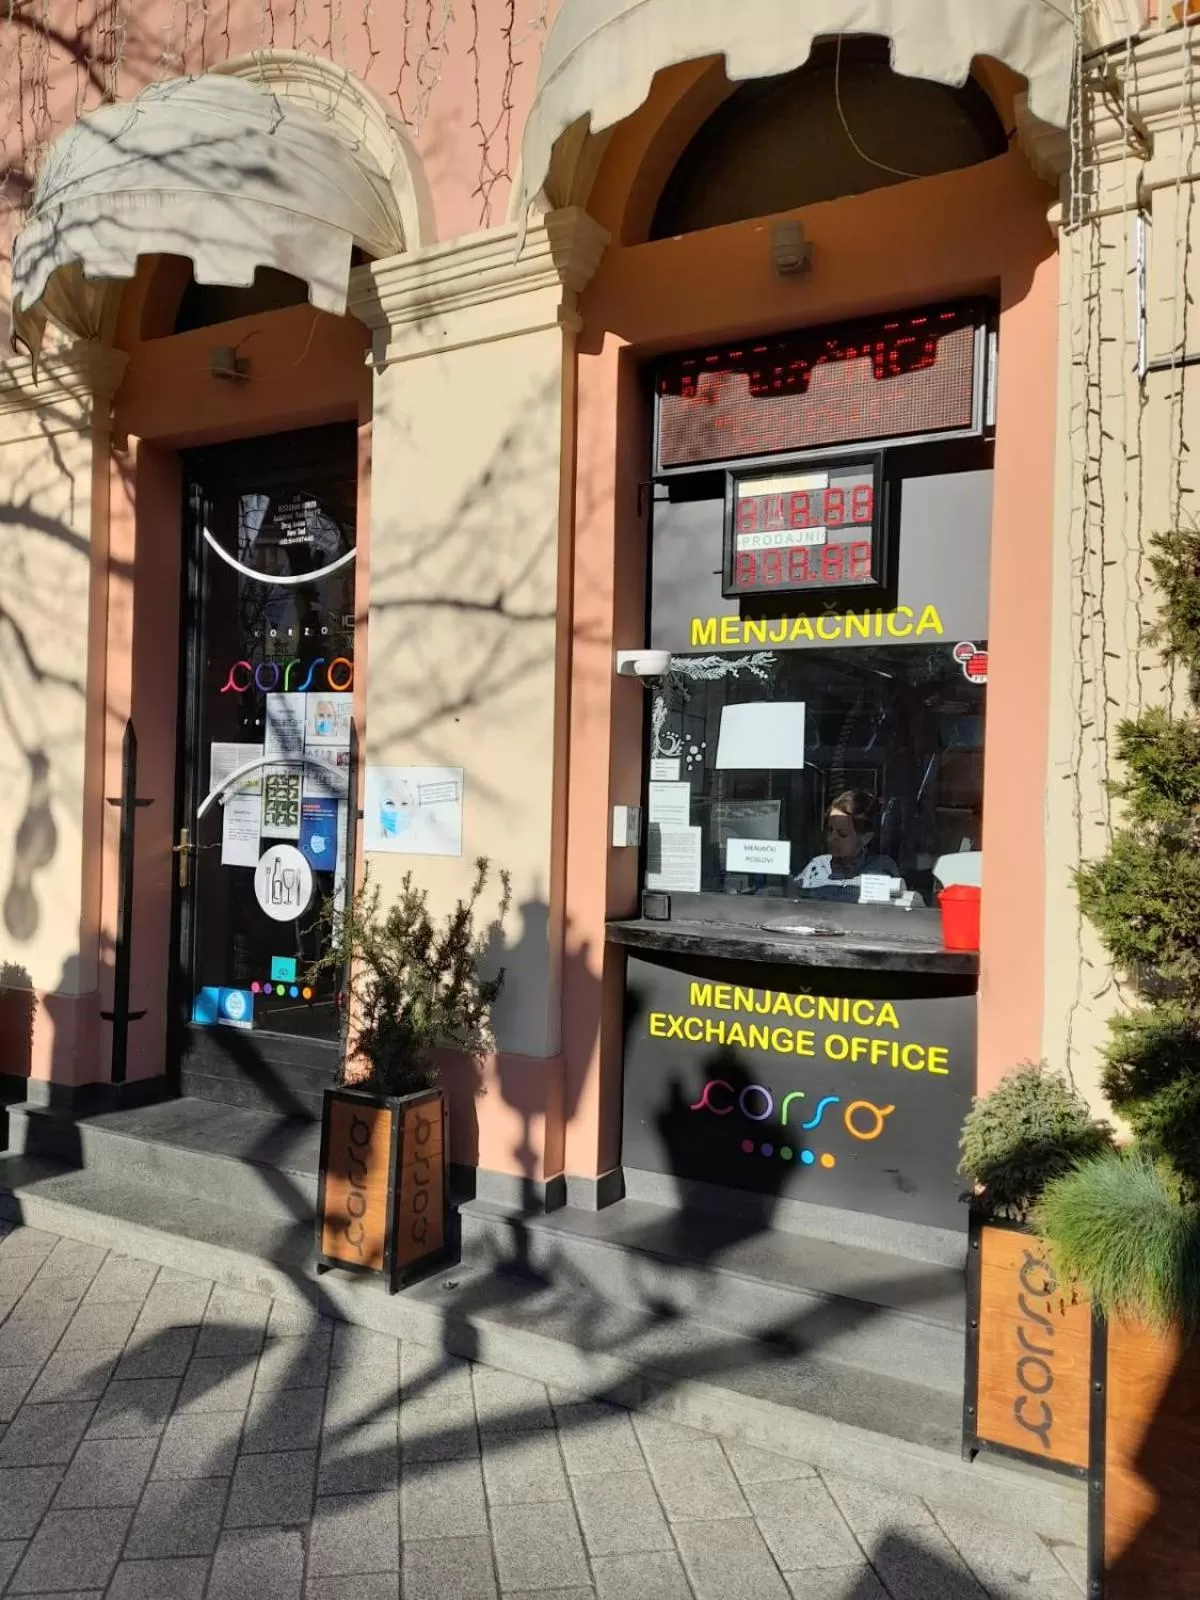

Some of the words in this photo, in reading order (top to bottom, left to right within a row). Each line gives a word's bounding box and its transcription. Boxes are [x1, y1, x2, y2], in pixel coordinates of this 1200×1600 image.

[742, 528, 820, 547] PRODAJNI
[690, 602, 945, 646] MENJAČNICA
[220, 657, 354, 692] corso
[689, 982, 900, 1029] MENJAČNICA
[649, 1012, 816, 1056] EXCHANGE
[824, 1033, 950, 1074] OFFICE
[689, 1079, 896, 1140] corso
[344, 1113, 371, 1257] corso
[411, 1111, 432, 1246] corso
[1013, 1248, 1056, 1449] corso
